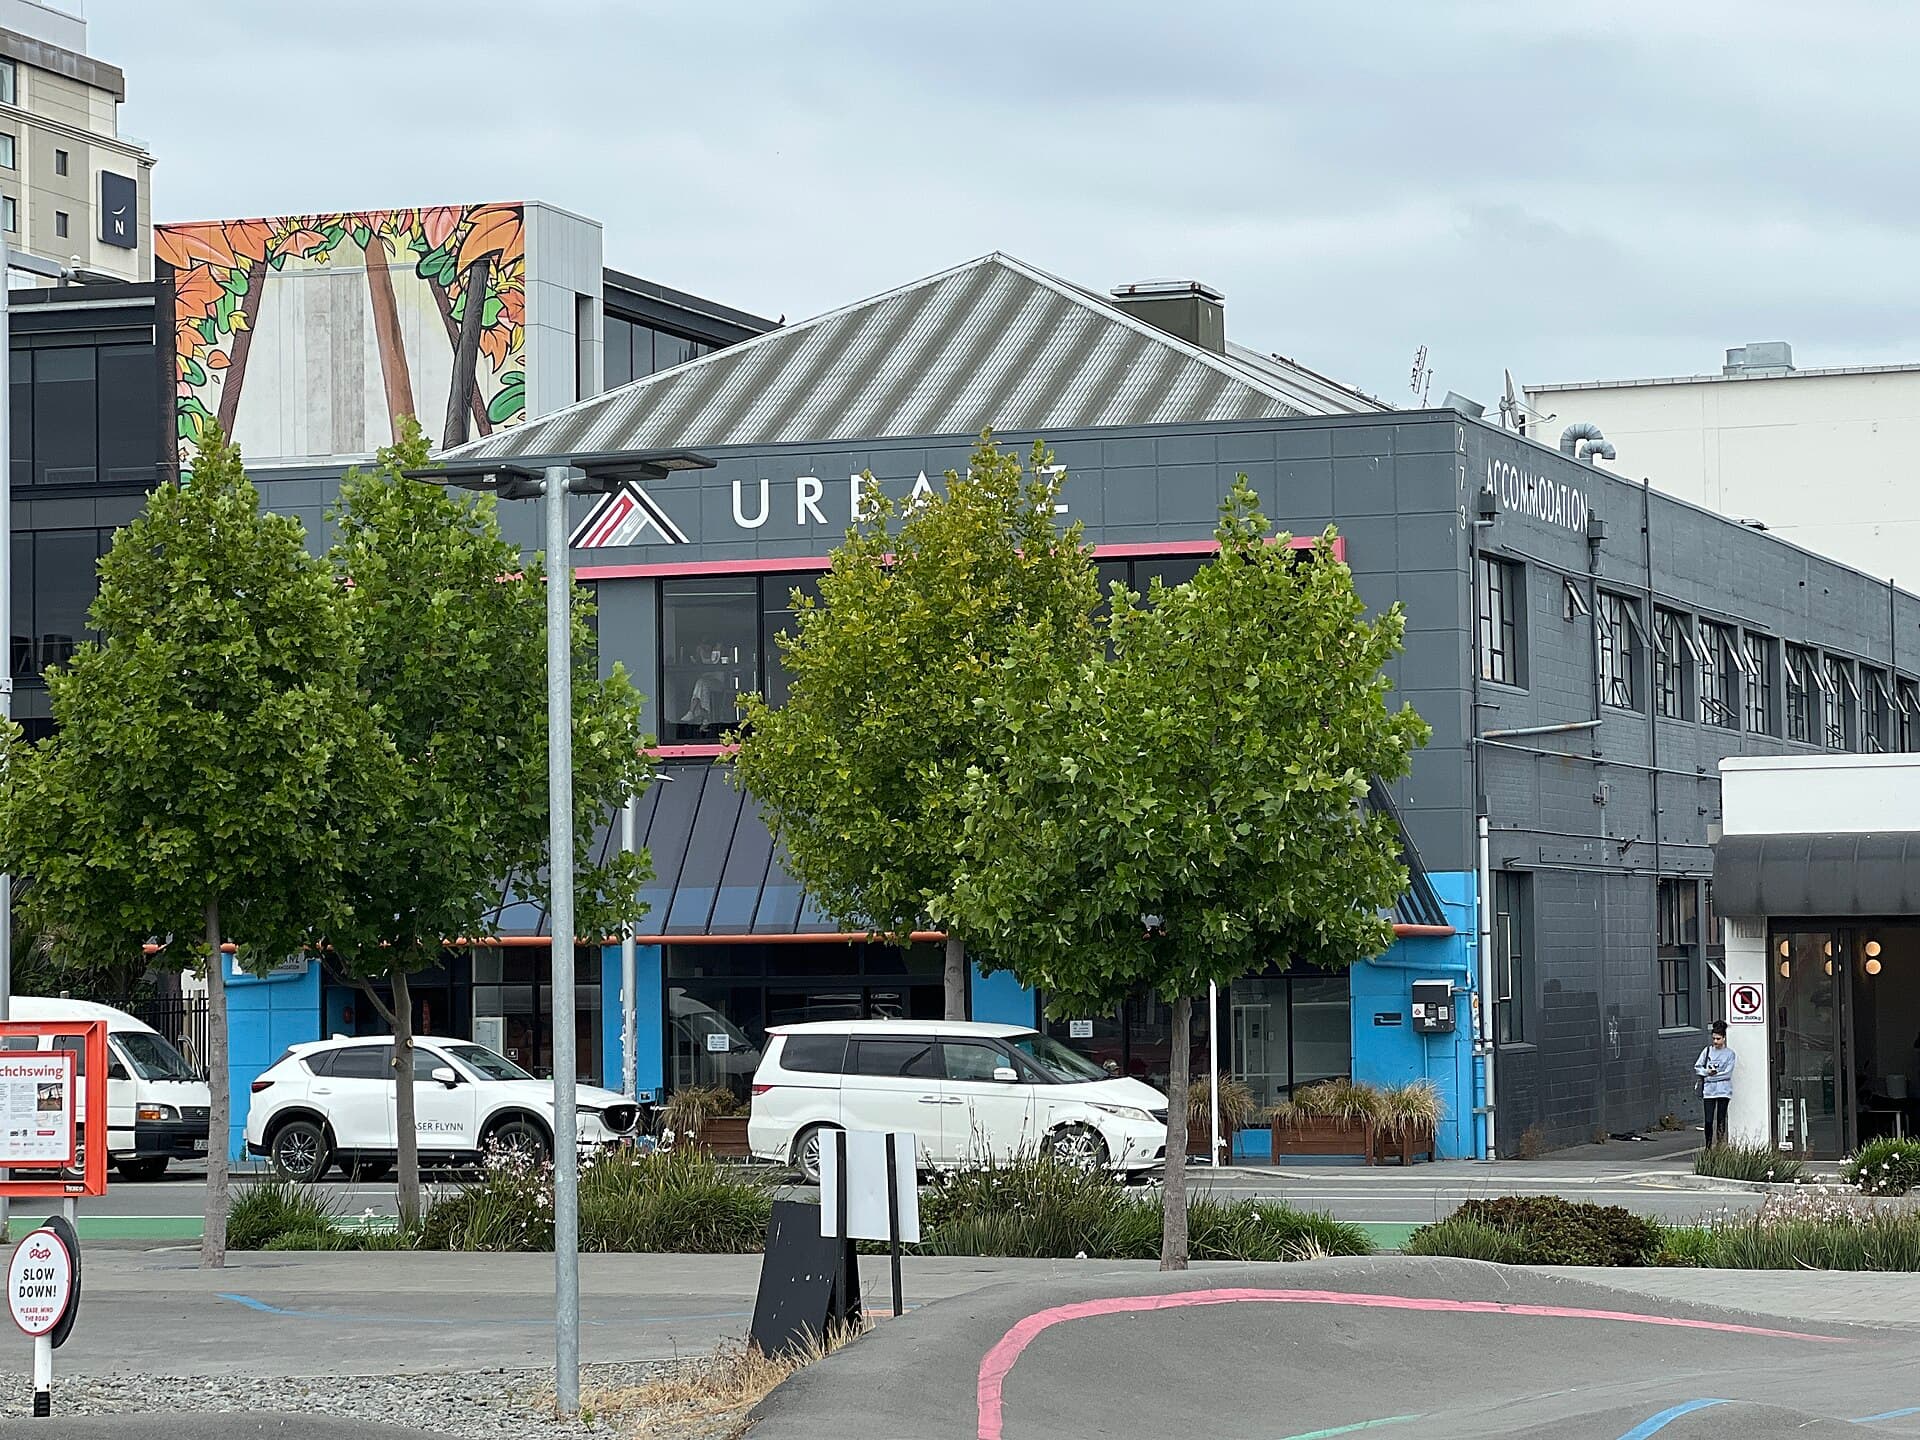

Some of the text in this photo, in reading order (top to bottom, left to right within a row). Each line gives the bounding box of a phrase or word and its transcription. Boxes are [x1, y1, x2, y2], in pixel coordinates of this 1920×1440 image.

[115, 219, 124, 236] N
[1486, 456, 1589, 534] ACCOMMODATION
[435, 1122, 464, 1131] FLYNN
[23, 1268, 55, 1281] SLOW
[19, 1285, 57, 1298] DOWN!
